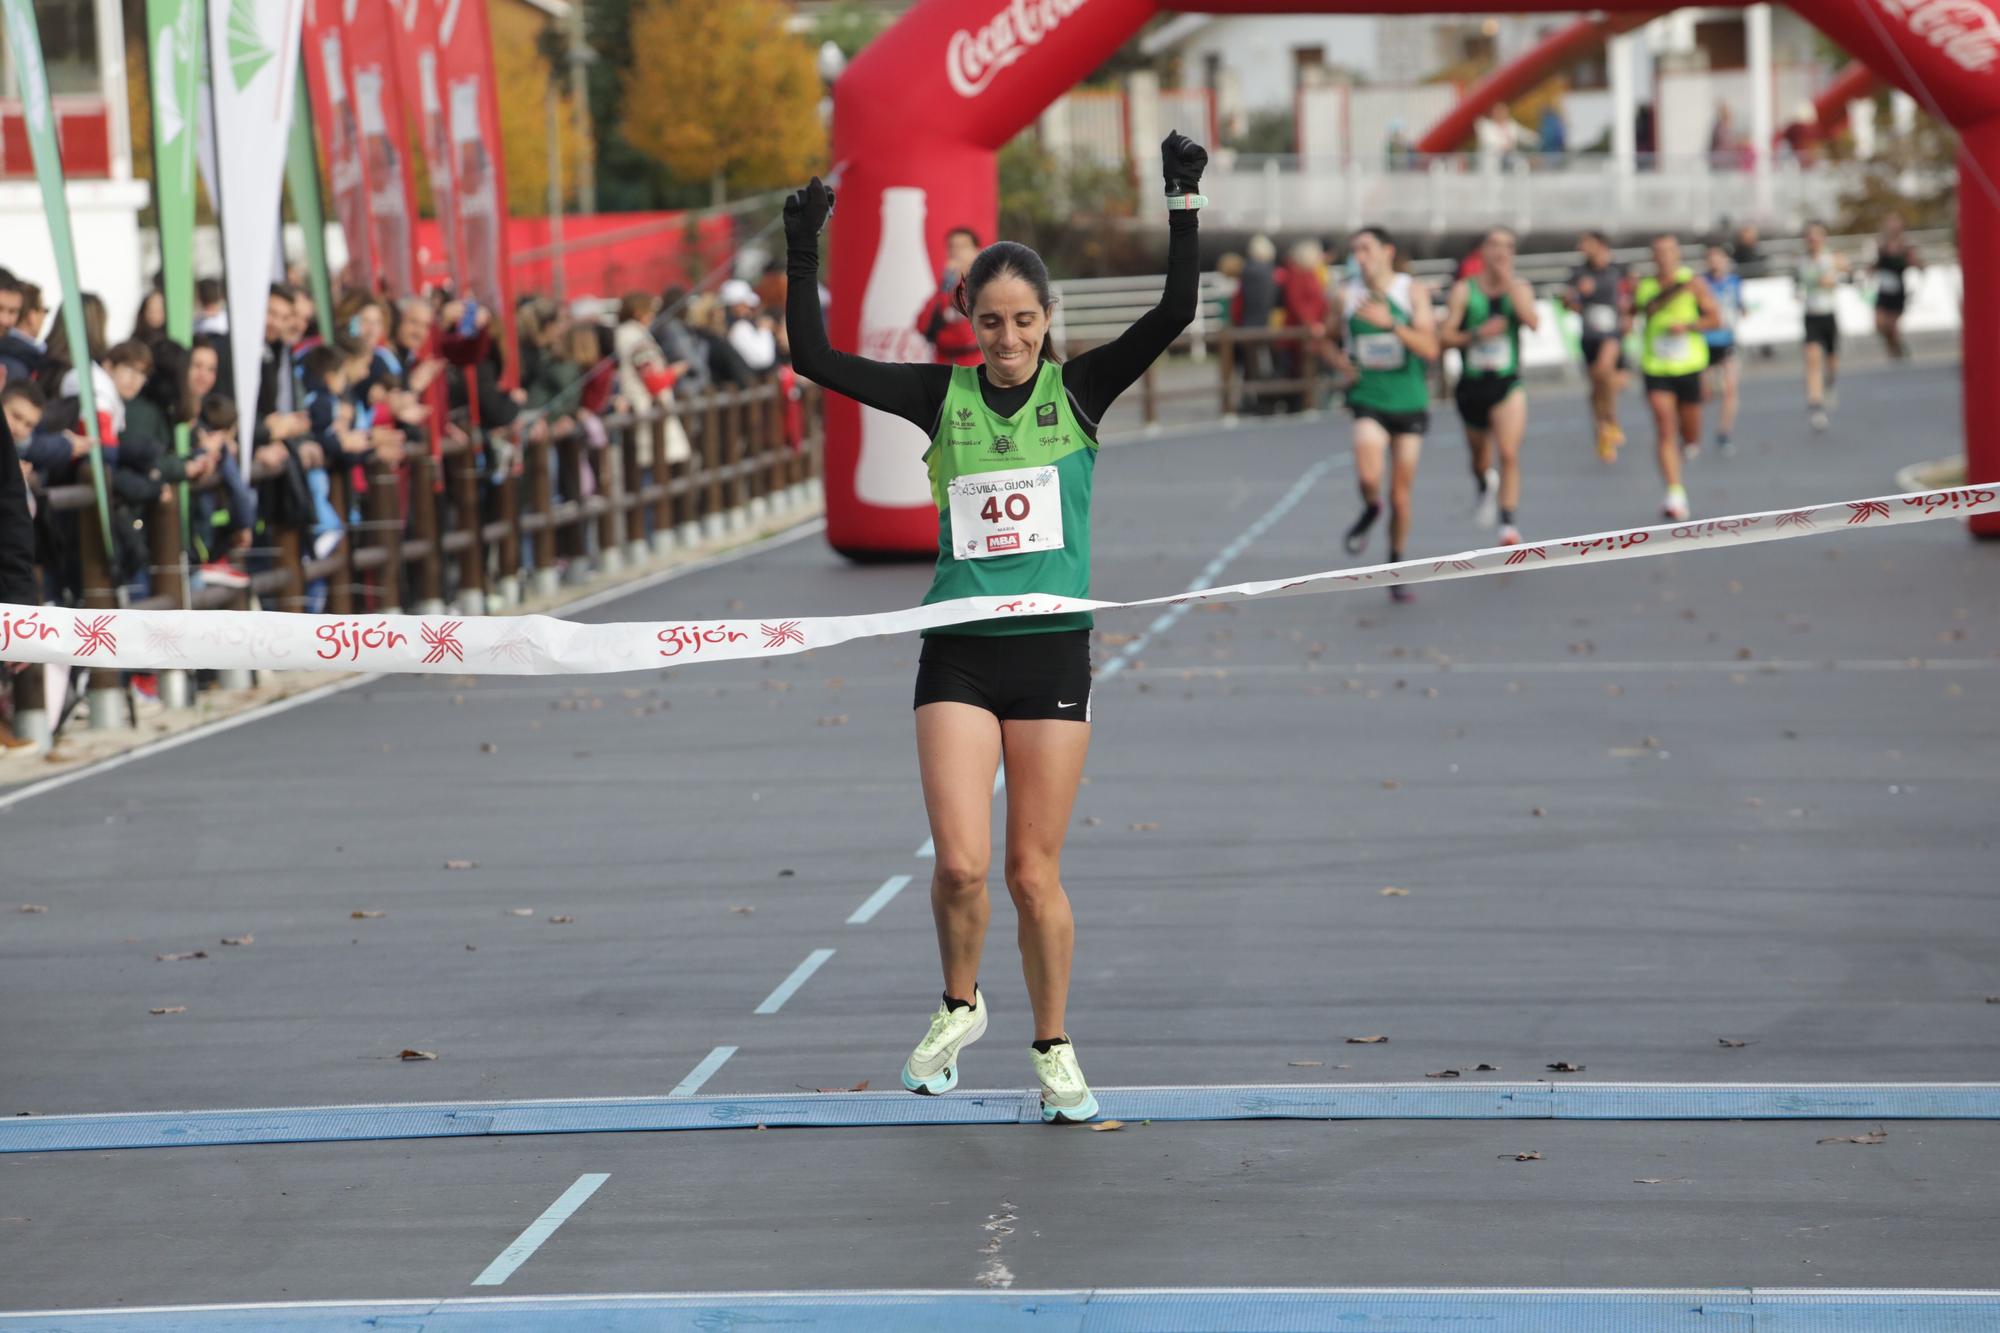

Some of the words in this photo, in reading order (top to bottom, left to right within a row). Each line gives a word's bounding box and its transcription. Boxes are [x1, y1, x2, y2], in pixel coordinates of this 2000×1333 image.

[980, 493, 1031, 524] 40
[990, 535, 1017, 547] MBA
[316, 621, 408, 662] gijón
[657, 624, 749, 657] gijón
